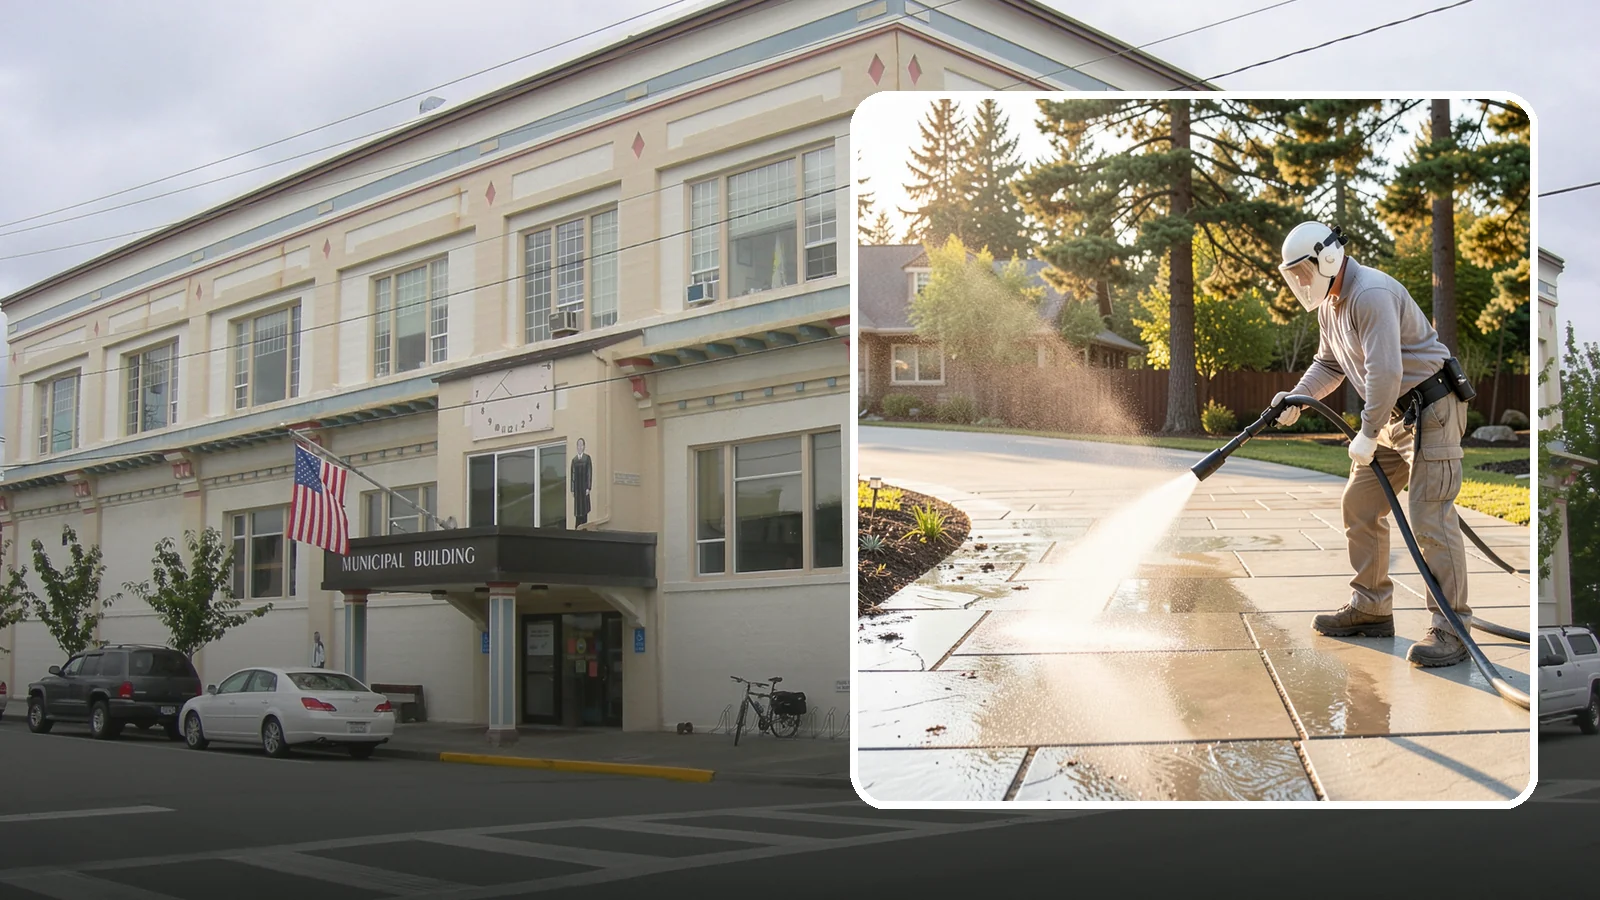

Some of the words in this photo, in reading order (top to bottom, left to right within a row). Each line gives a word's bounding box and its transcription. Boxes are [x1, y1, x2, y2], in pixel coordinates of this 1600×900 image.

[481, 407, 484, 415] 8
[488, 418, 492, 426] 9
[342, 552, 405, 572] MUNICIPAL
[414, 546, 475, 567] BUILDING
